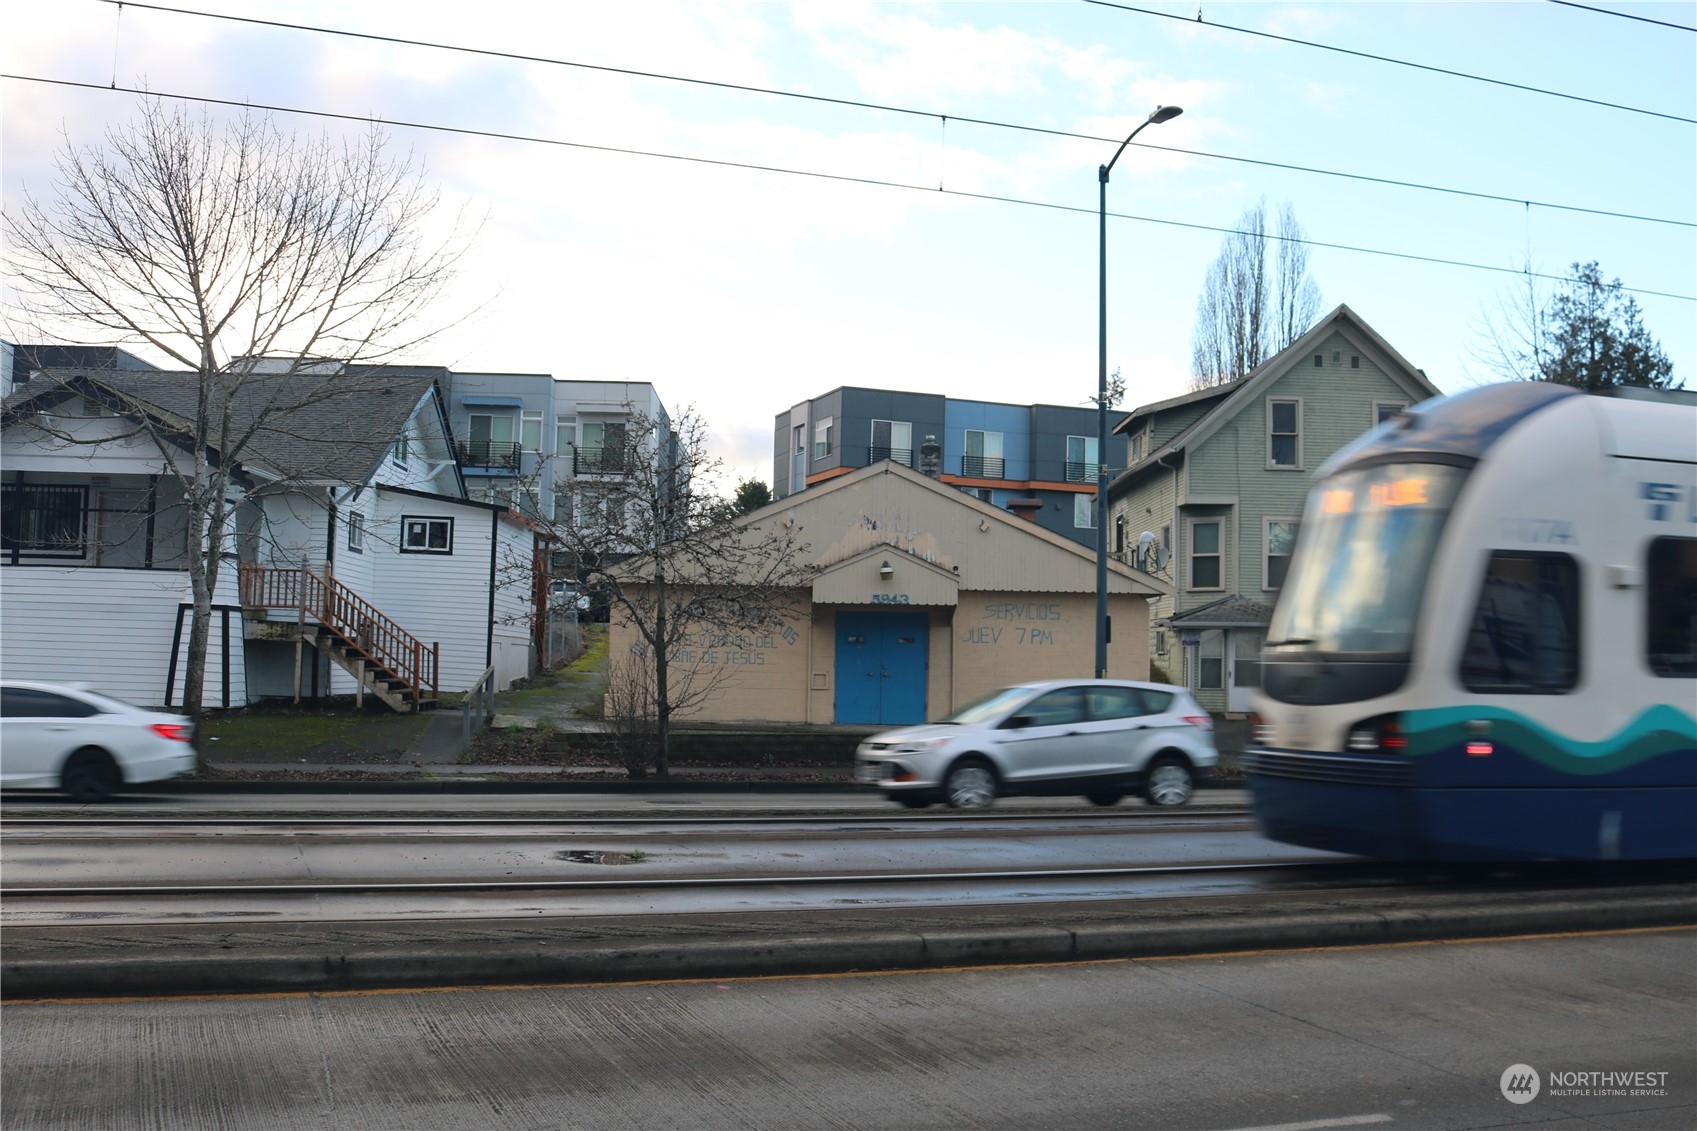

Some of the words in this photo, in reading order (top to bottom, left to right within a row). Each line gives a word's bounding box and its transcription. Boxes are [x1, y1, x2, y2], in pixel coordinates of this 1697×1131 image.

[872, 593, 909, 605] 5943
[982, 603, 1061, 621] SERVICIOS
[962, 626, 1003, 645] JUEV
[1015, 627, 1027, 645] 7
[1030, 628, 1054, 645] PM
[755, 636, 778, 649] DEL
[702, 651, 719, 664] DE
